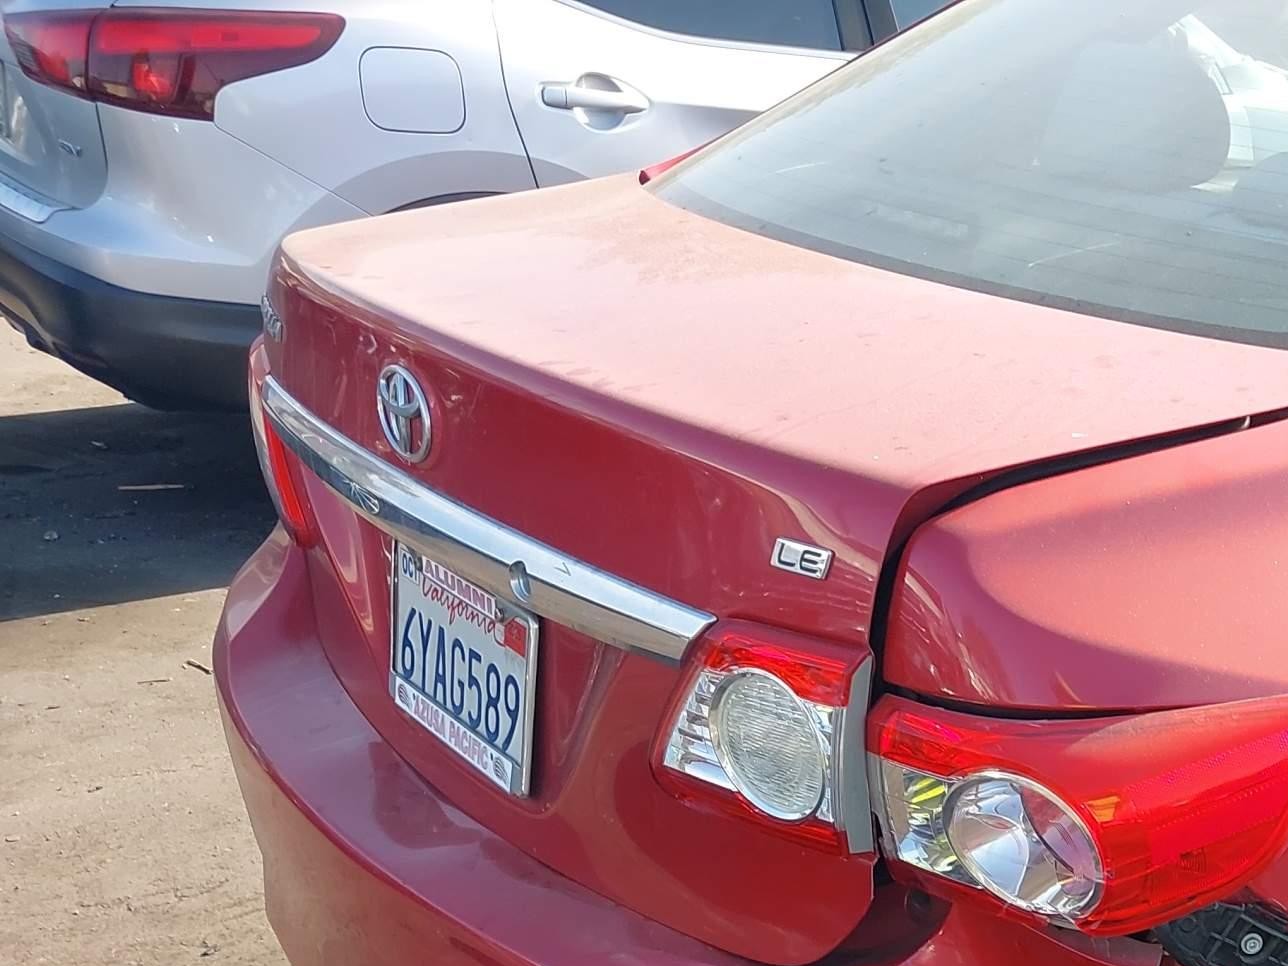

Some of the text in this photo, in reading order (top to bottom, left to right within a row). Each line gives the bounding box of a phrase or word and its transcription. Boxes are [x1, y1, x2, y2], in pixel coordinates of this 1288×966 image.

[423, 559, 494, 618] ALUMNI
[777, 541, 822, 574] LE
[401, 607, 520, 753] 6YAG589
[413, 694, 489, 771] AZUSA PACIFIC
